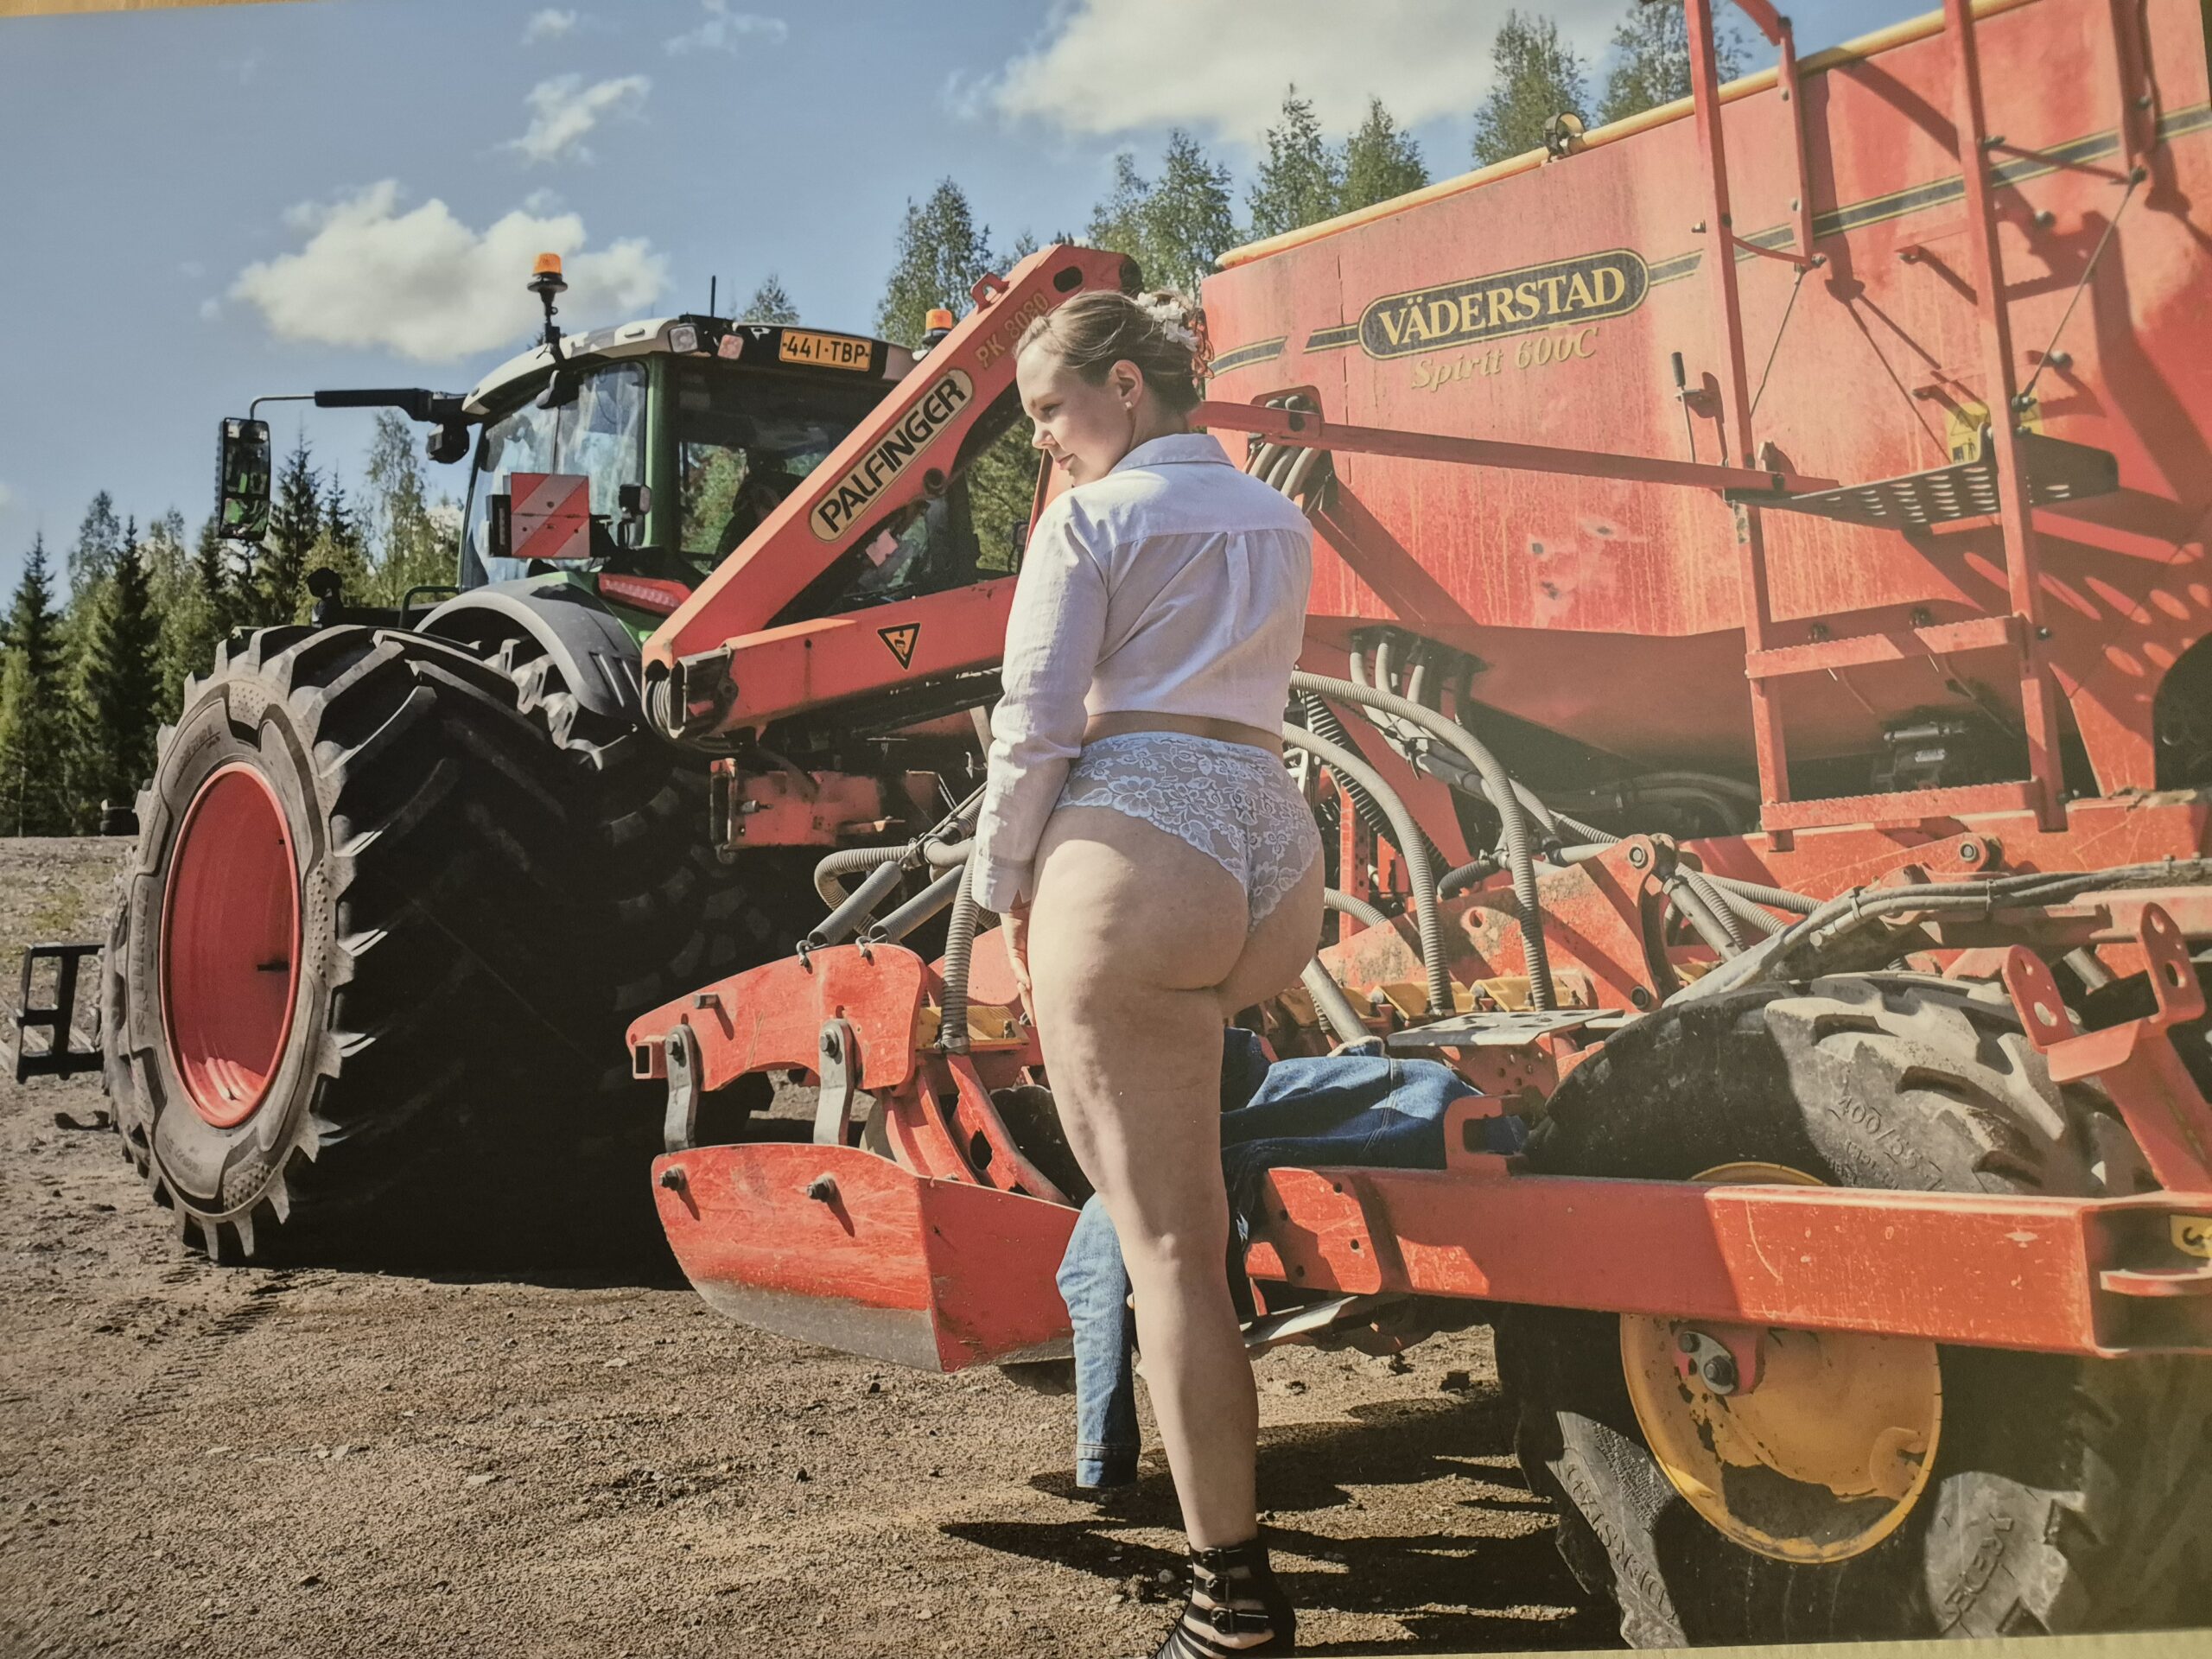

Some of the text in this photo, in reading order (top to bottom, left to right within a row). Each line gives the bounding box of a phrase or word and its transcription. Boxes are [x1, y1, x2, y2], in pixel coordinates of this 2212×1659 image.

[1377, 266, 1626, 346] VÄDERSTAD
[974, 333, 1006, 369] PK
[1410, 347, 1505, 393] Spirit
[817, 378, 967, 534] PALFINGER
